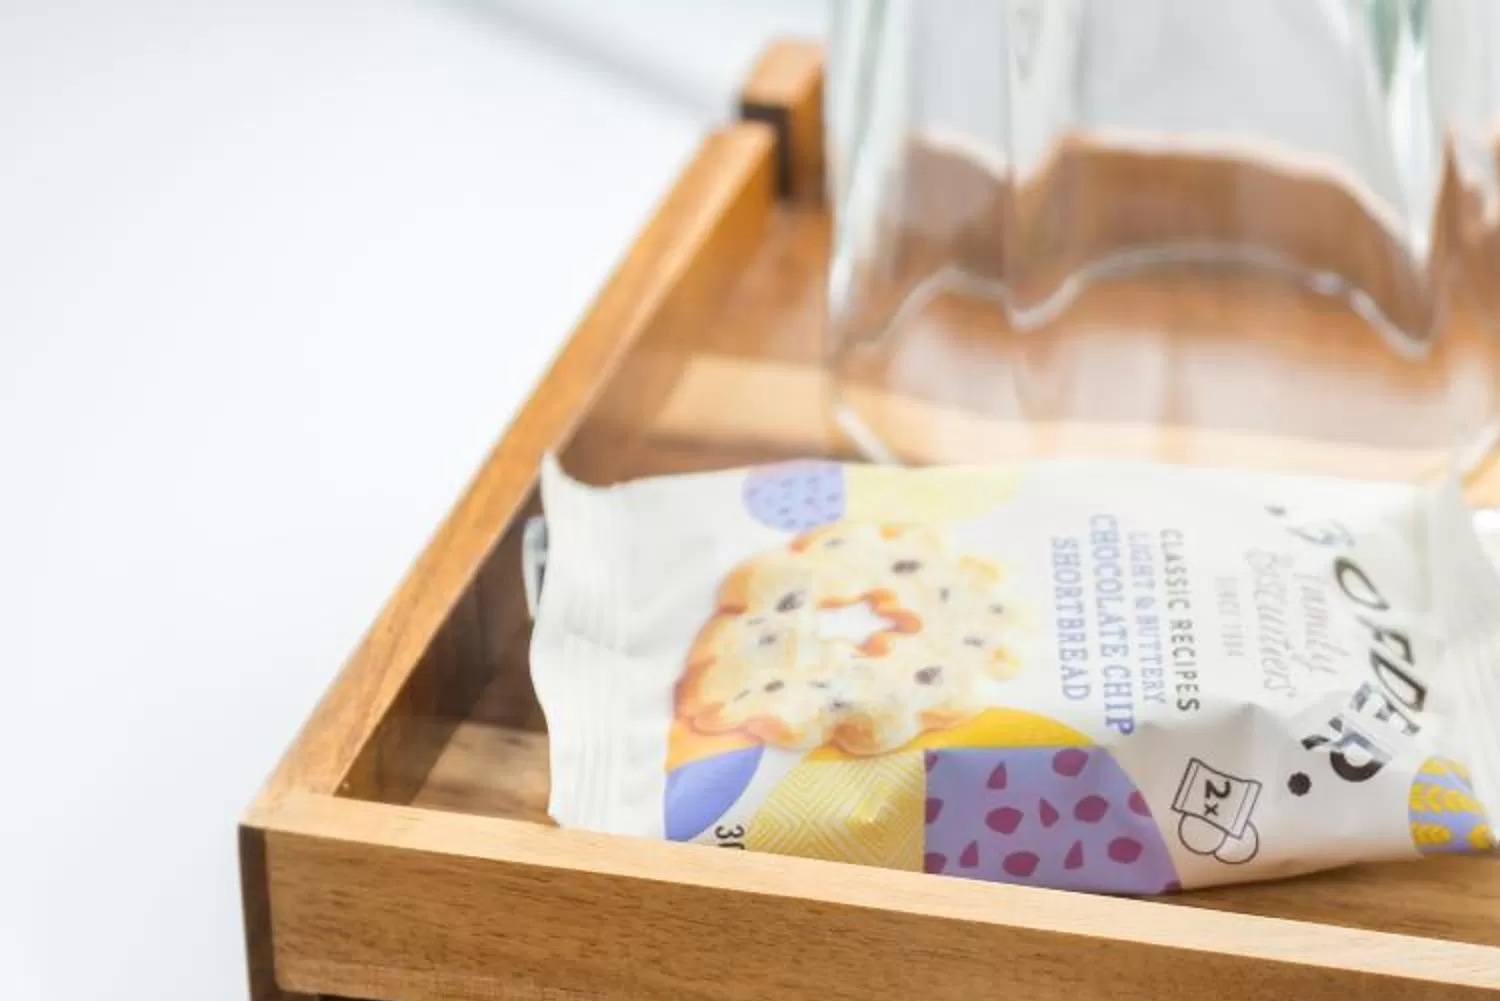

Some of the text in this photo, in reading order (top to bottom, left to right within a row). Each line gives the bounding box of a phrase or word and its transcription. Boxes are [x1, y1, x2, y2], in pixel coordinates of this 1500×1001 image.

[1050, 536, 1091, 702] SHORTBREAD
[1127, 531, 1157, 589] LIGHT
[1160, 529, 1200, 712] CLASSIC RECIPES
[1088, 514, 1136, 736] CHOCOLATE CHIP
[1135, 613, 1166, 705] BUTTERY
[1204, 779, 1232, 817] 2x
